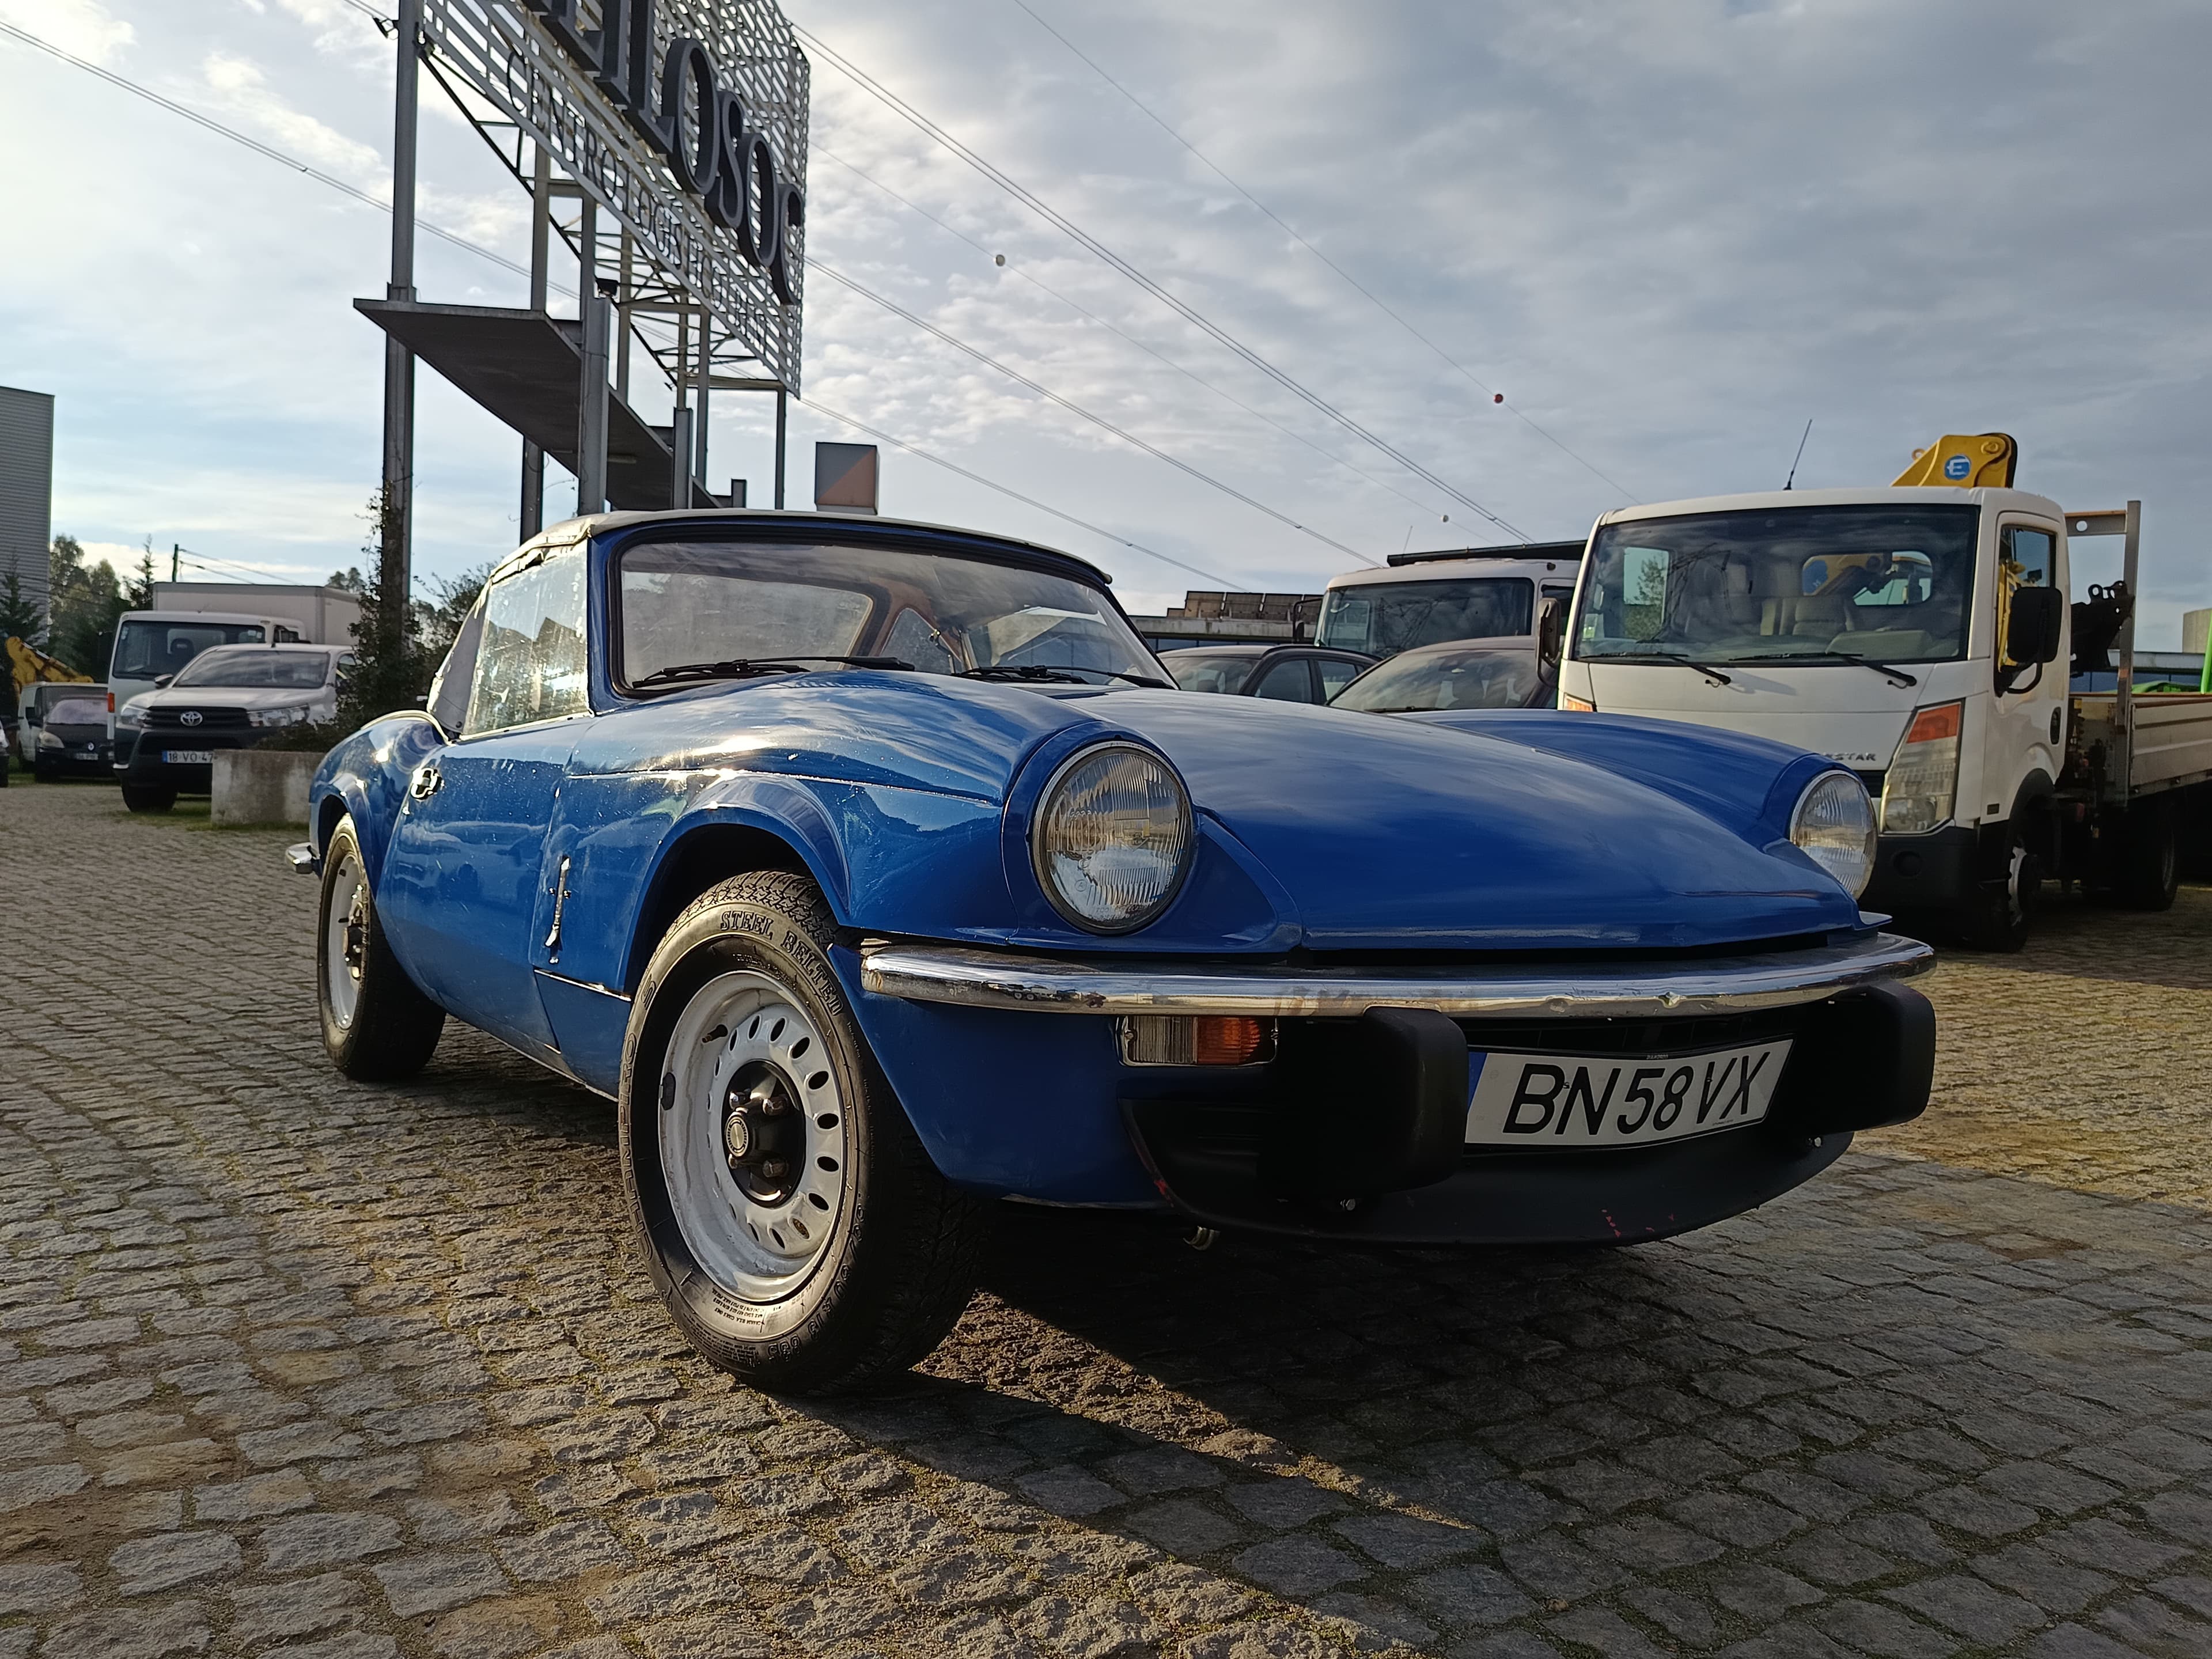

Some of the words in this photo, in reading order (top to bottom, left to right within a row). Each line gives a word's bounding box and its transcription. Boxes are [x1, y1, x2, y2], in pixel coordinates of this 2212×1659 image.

[721, 911, 774, 940] STEEL
[780, 930, 844, 1016] BELTED
[620, 1032, 653, 1261] CHAMPIRO
